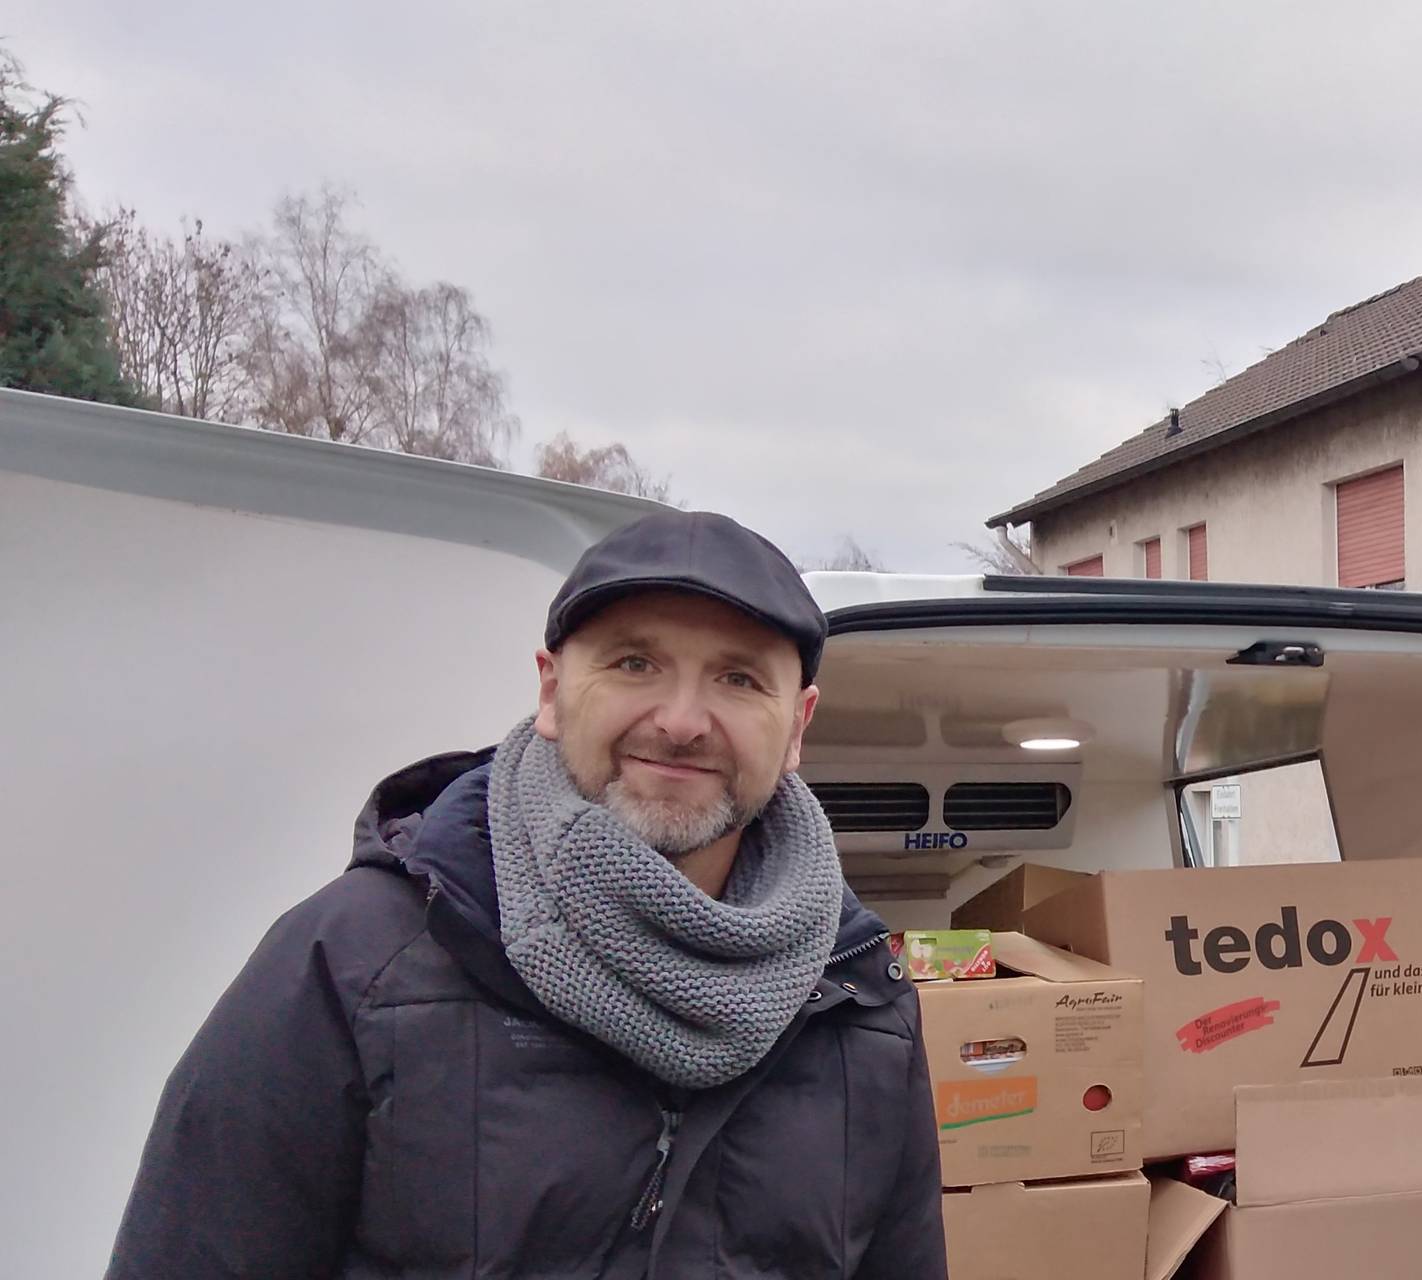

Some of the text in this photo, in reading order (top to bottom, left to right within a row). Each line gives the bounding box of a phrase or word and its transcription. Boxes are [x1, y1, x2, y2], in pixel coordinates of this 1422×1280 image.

[904, 832, 968, 849] HEIFO
[1165, 906, 1398, 976] tedox
[1374, 965, 1401, 980] und
[1370, 984, 1390, 998] für
[1055, 992, 1123, 1010] AgroFair
[1194, 1016, 1212, 1030] Der
[1195, 1022, 1245, 1048] Discounter
[945, 1088, 1027, 1118] demeter
